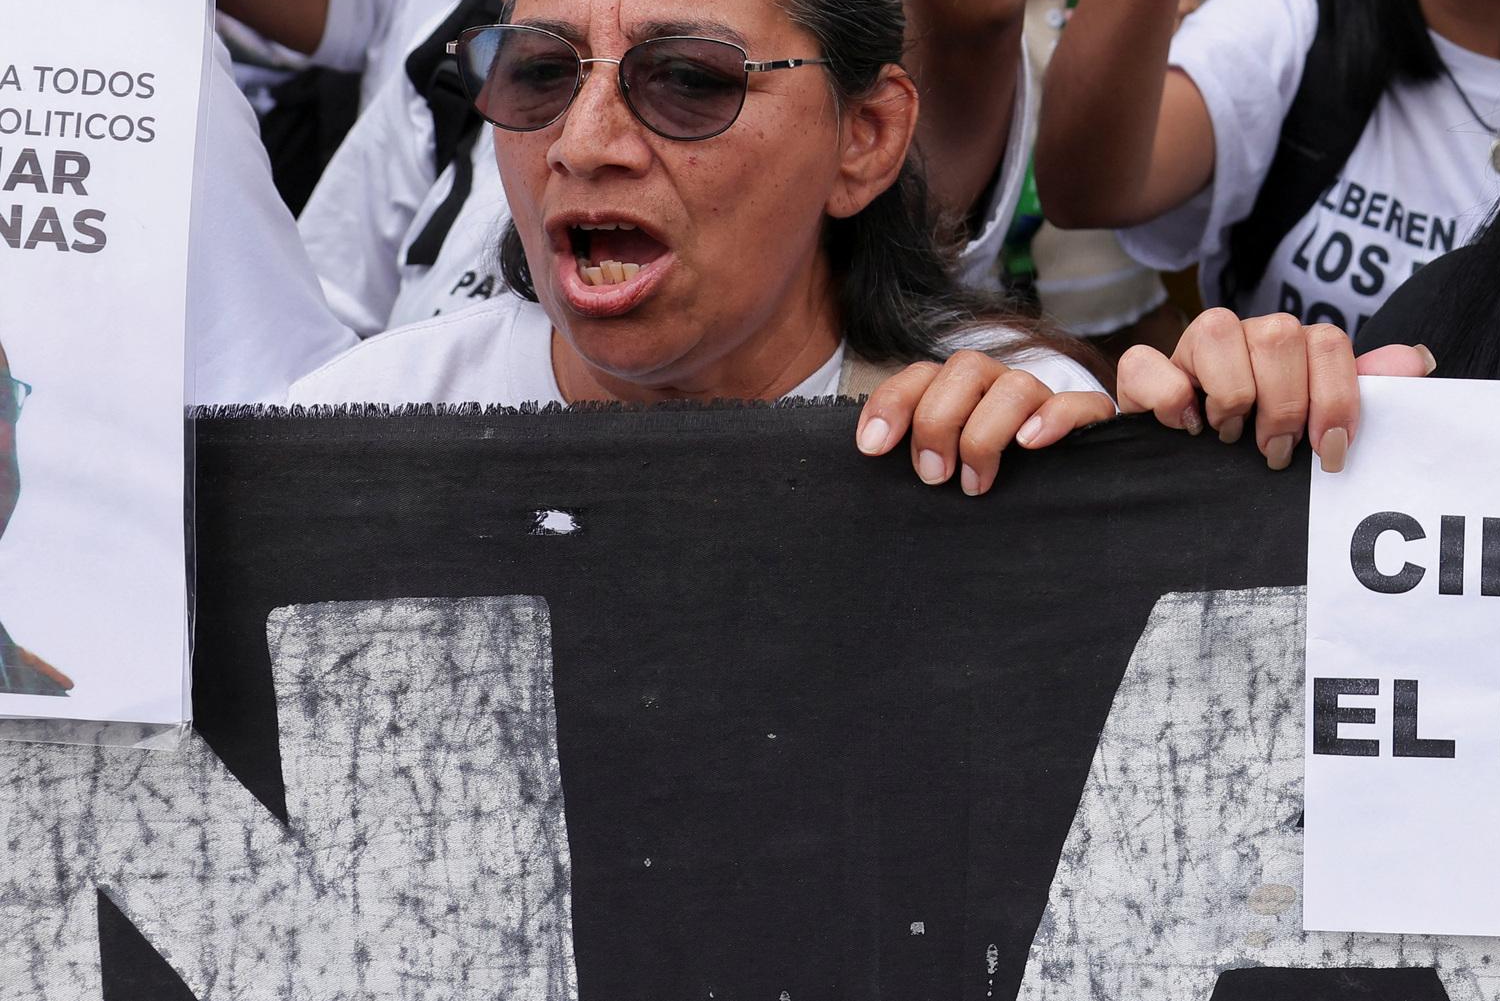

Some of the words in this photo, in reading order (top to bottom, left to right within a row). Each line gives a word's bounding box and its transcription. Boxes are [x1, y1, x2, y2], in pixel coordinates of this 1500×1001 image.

[0, 64, 22, 91] A
[33, 66, 155, 99] TODOS
[1313, 678, 1456, 758] EL
